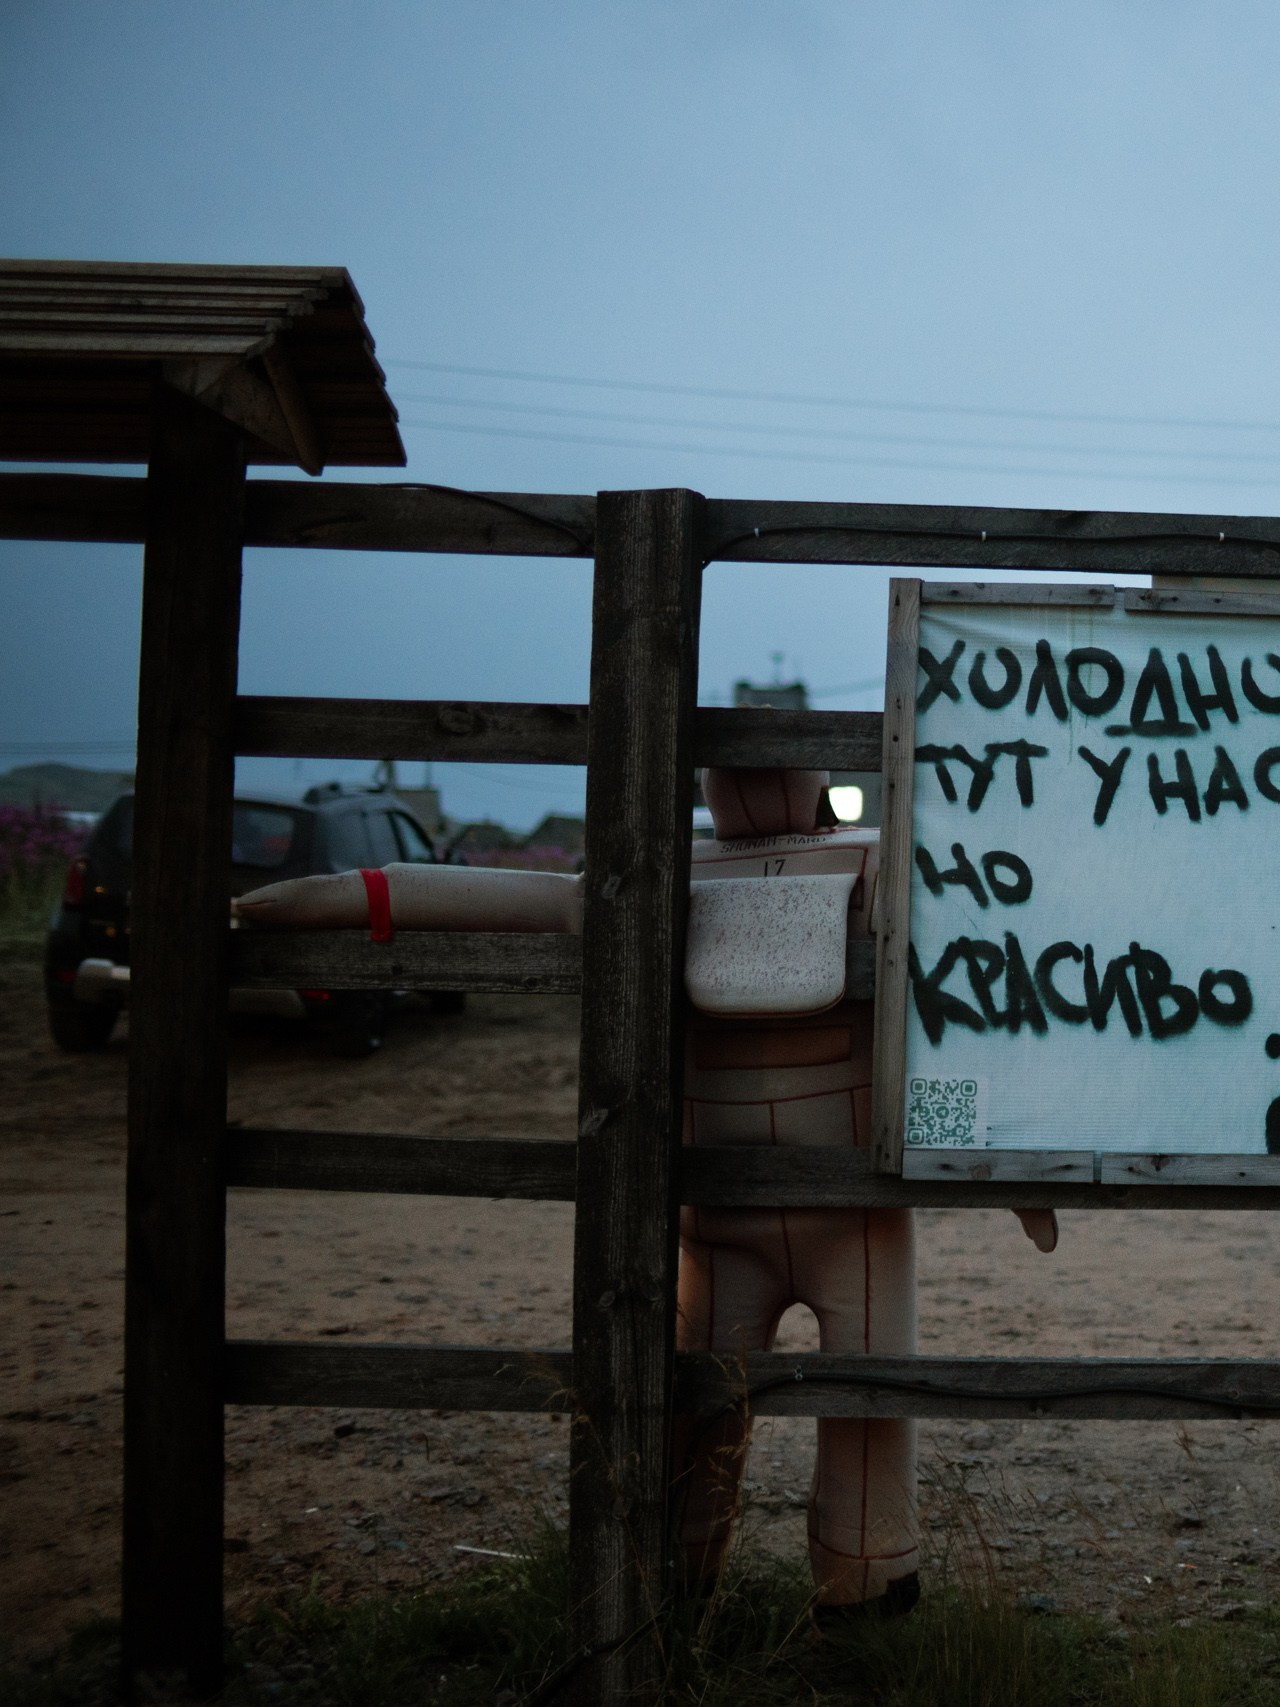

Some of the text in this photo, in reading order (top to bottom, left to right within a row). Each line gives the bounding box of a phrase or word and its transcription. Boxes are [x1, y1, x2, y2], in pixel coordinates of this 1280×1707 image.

[915, 738, 1049, 813] ТУТ
[763, 858, 787, 877] 17
[915, 841, 1034, 910] НО
